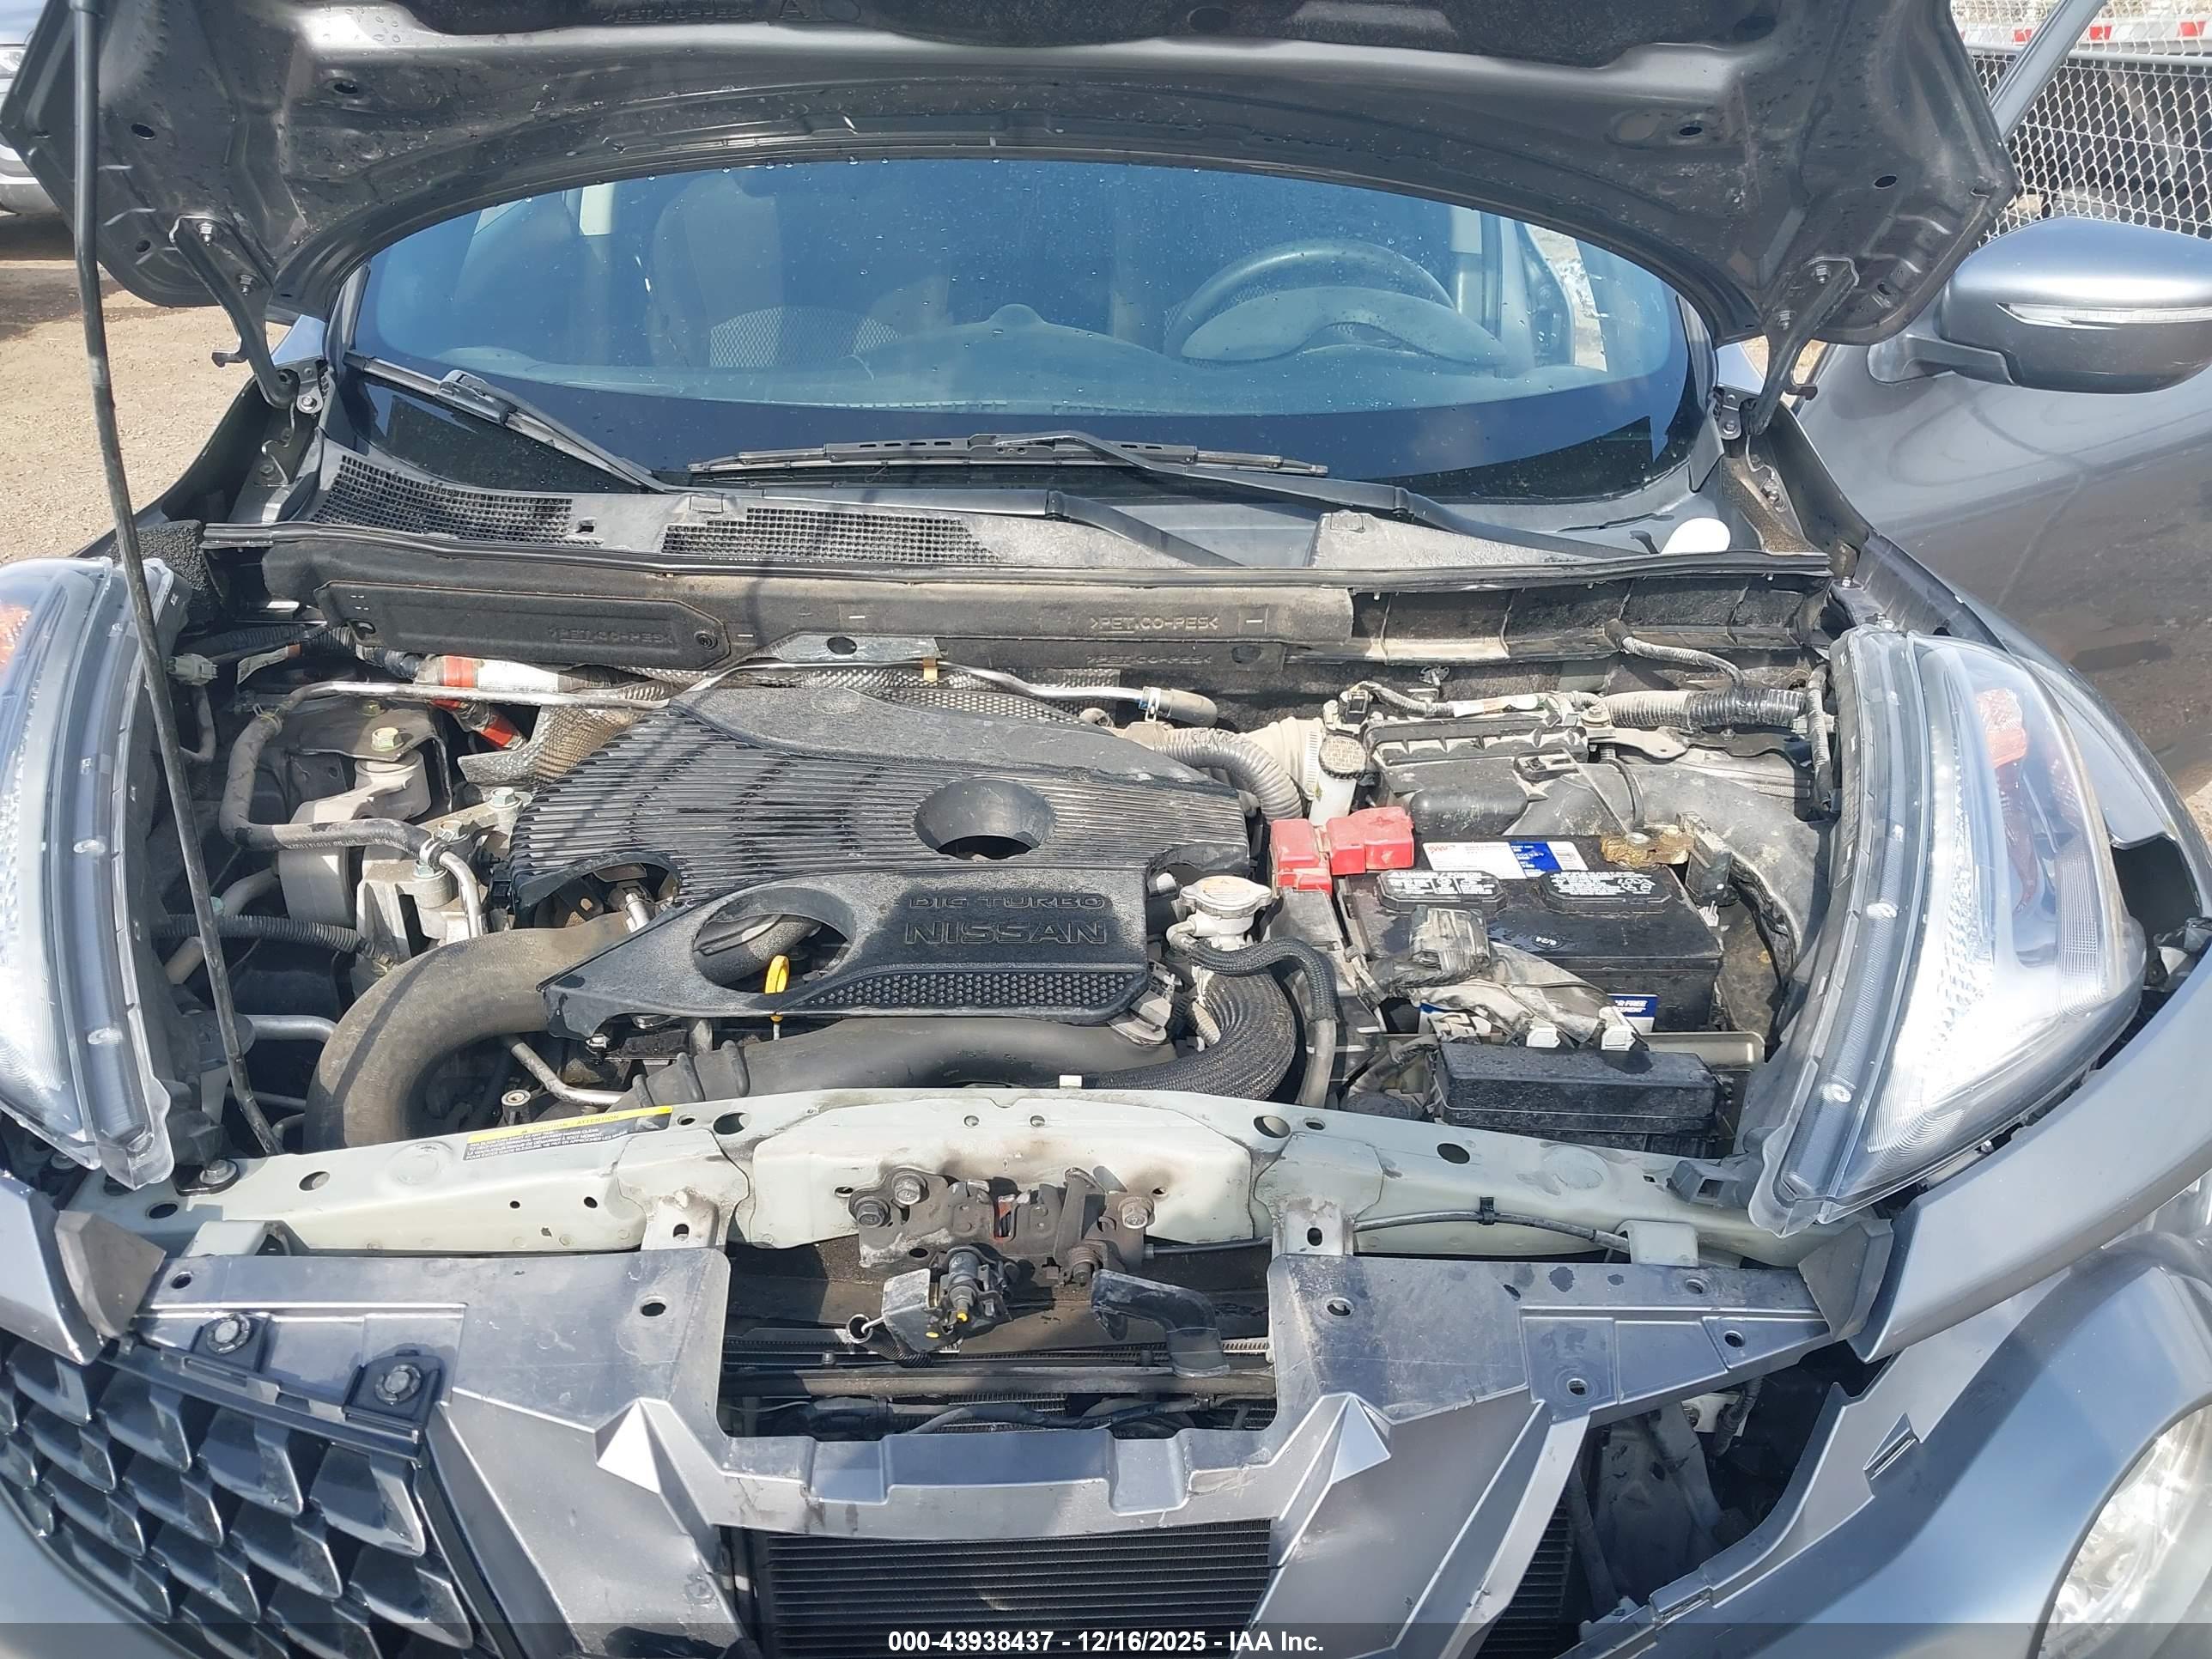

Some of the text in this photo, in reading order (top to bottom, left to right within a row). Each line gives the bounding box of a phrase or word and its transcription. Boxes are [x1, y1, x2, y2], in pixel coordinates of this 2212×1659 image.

[908, 896, 1105, 908] DIG TURBO
[905, 921, 1108, 944] NISSAN
[576, 1115, 619, 1125] ATTENTION
